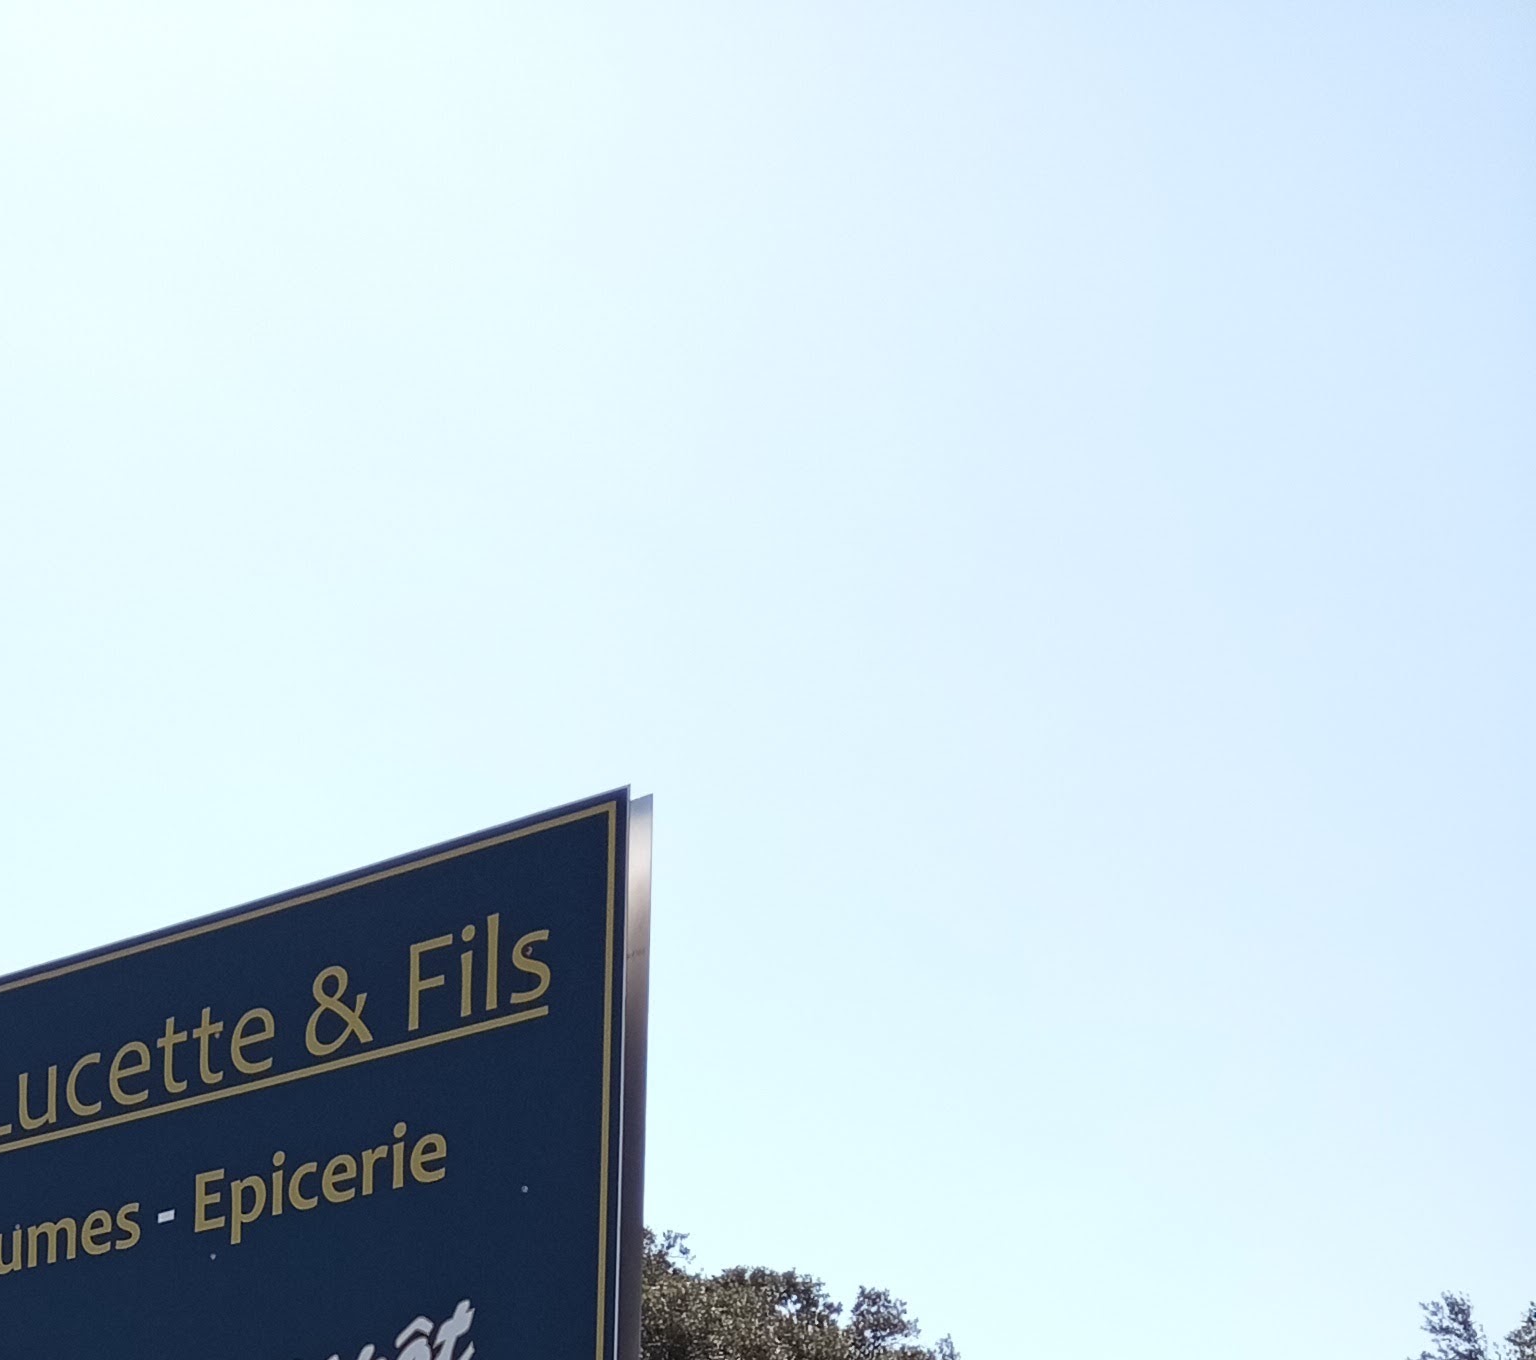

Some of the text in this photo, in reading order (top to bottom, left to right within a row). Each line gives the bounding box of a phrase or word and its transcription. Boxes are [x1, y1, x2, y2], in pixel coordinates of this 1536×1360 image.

[306, 966, 374, 1056] &
[407, 912, 552, 1030] Fils
[157, 1210, 176, 1225] -
[193, 1121, 448, 1243] Epicerie
